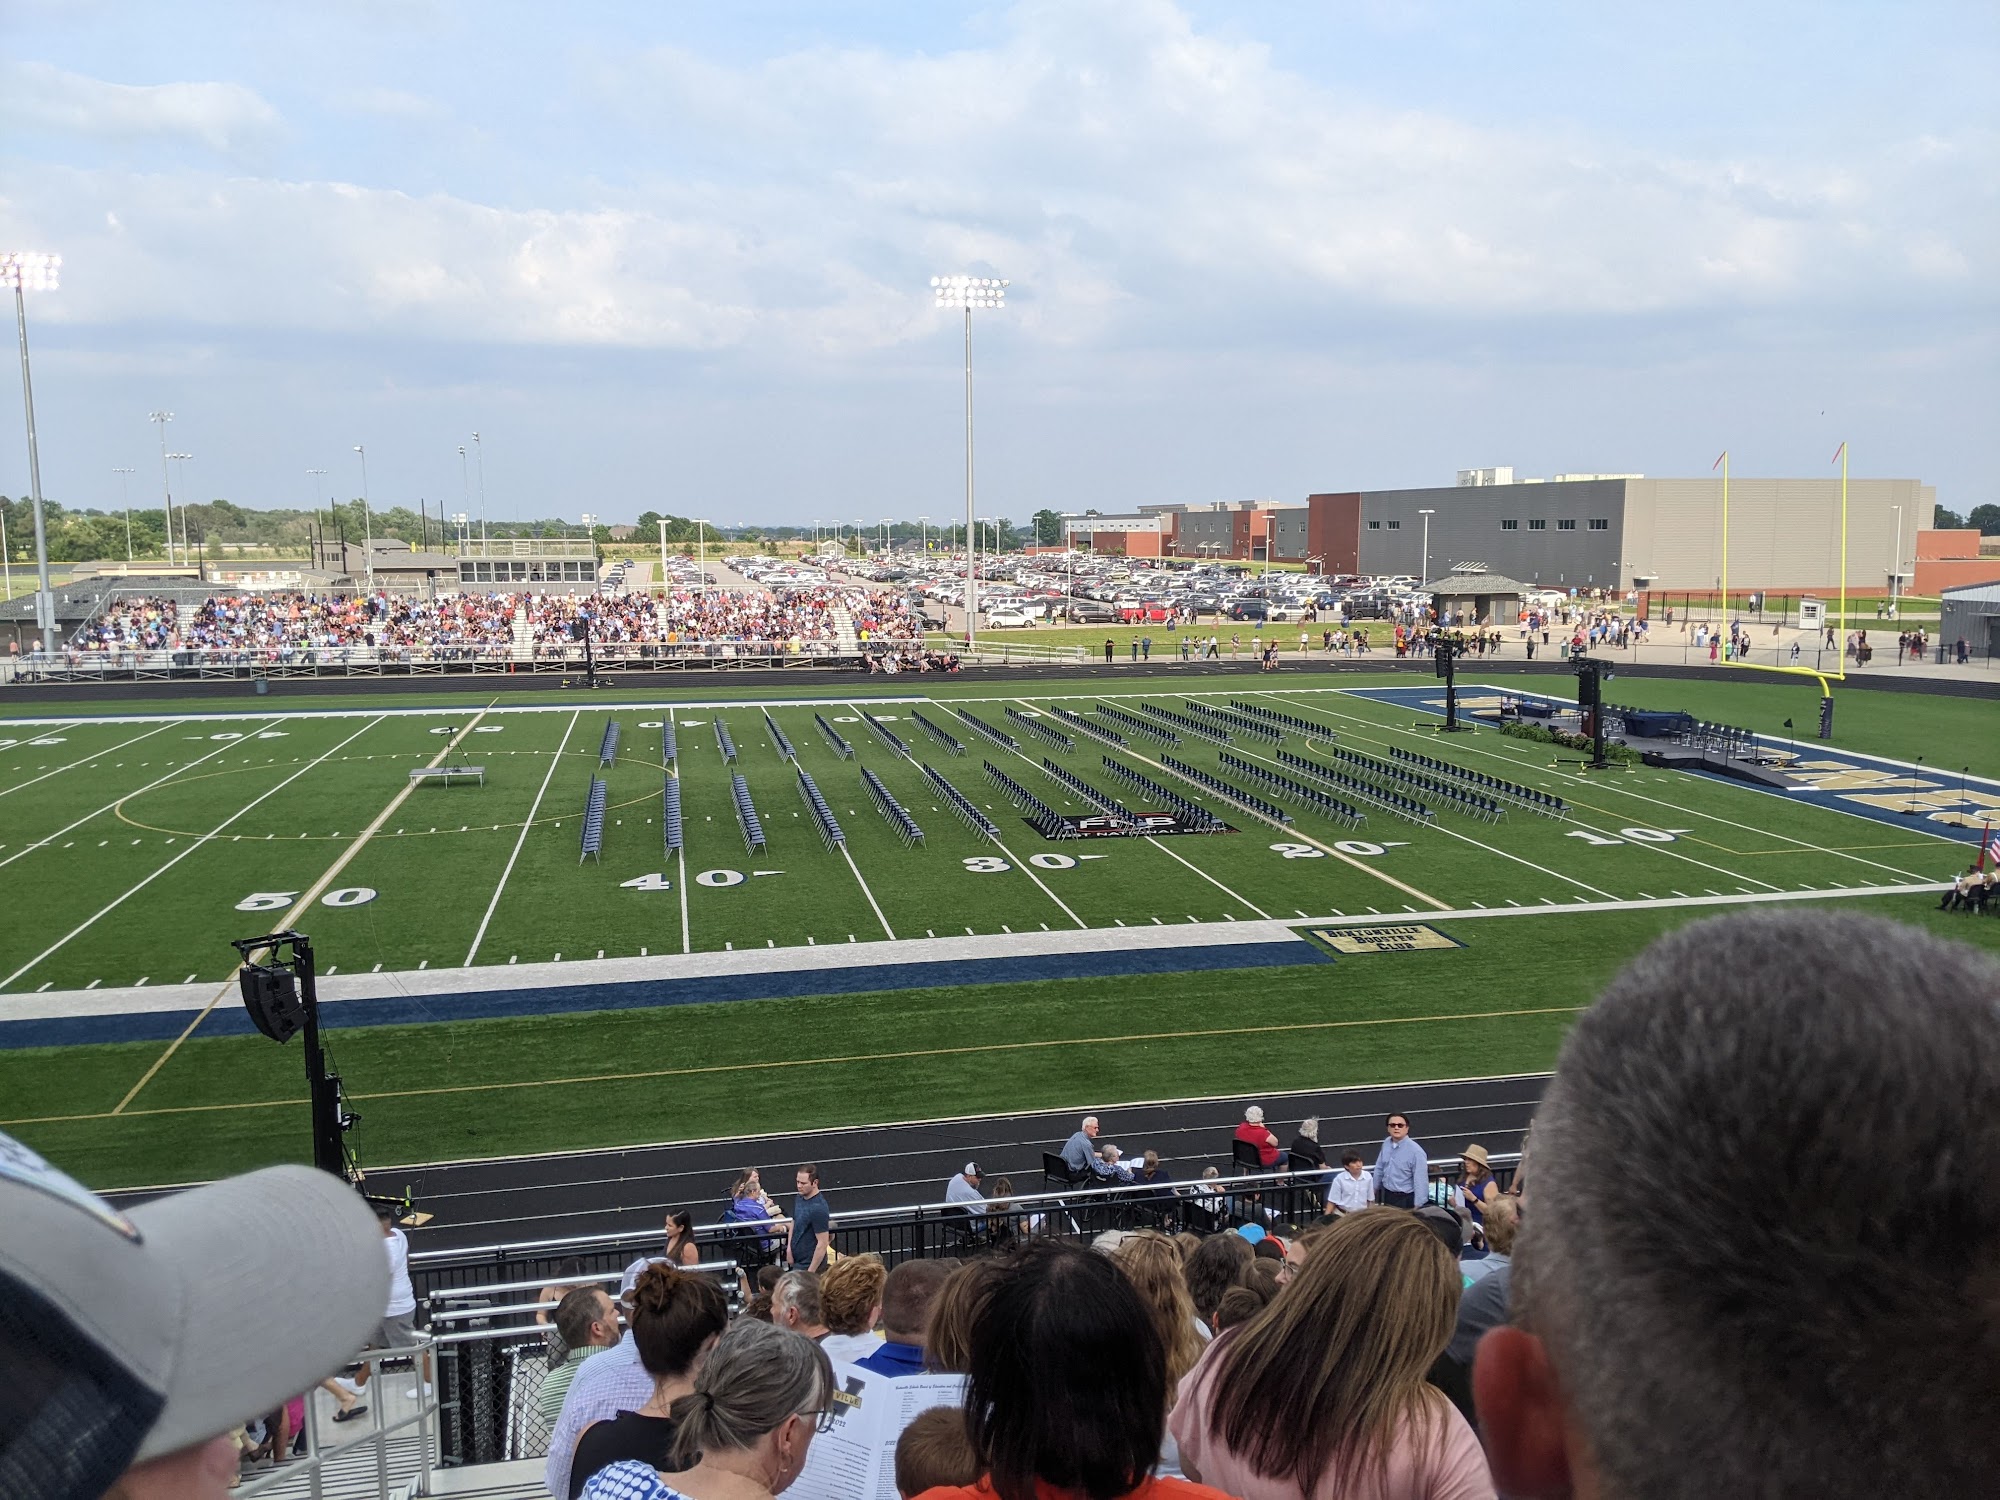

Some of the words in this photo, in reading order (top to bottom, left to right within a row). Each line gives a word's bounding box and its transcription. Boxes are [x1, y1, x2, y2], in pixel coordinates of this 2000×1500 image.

[1566, 827, 1679, 846] 10
[1269, 840, 1388, 859] 20
[962, 853, 1077, 873] 30
[619, 868, 747, 892] 40
[235, 887, 378, 911] 50
[1325, 927, 1422, 938] BENTONVILLE
[1353, 934, 1417, 944] BOOSTER
[1376, 942, 1415, 950] CLUB
